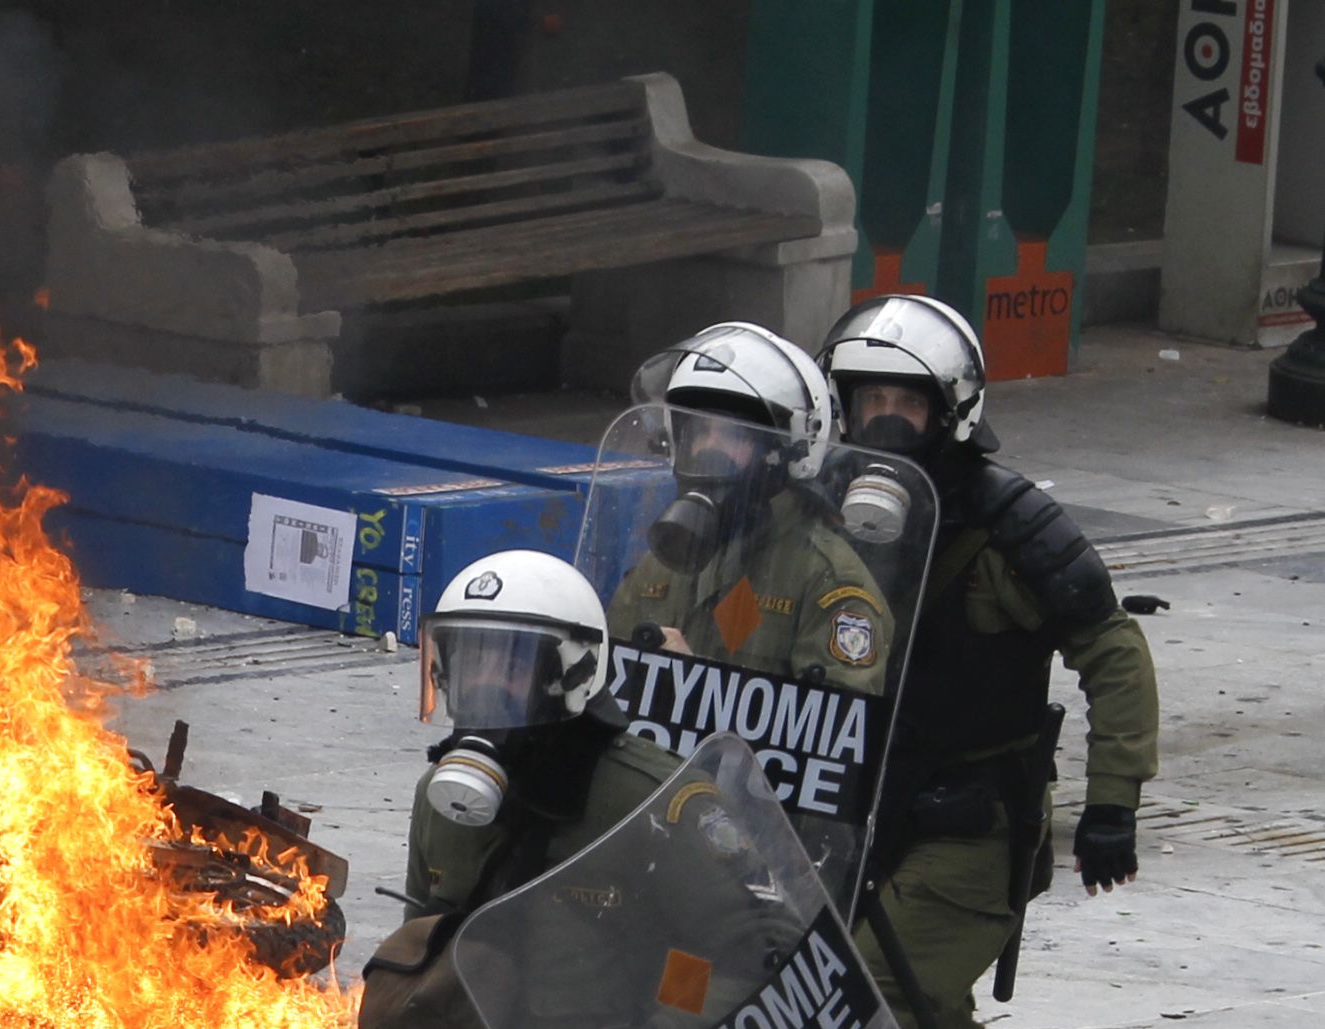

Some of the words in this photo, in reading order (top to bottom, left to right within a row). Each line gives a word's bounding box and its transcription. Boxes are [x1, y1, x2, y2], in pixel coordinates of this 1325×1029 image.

[986, 285, 1069, 320] metro
[401, 577, 415, 631] ress
[609, 645, 867, 765] ΣΤΥΝΟΜΙΑ
